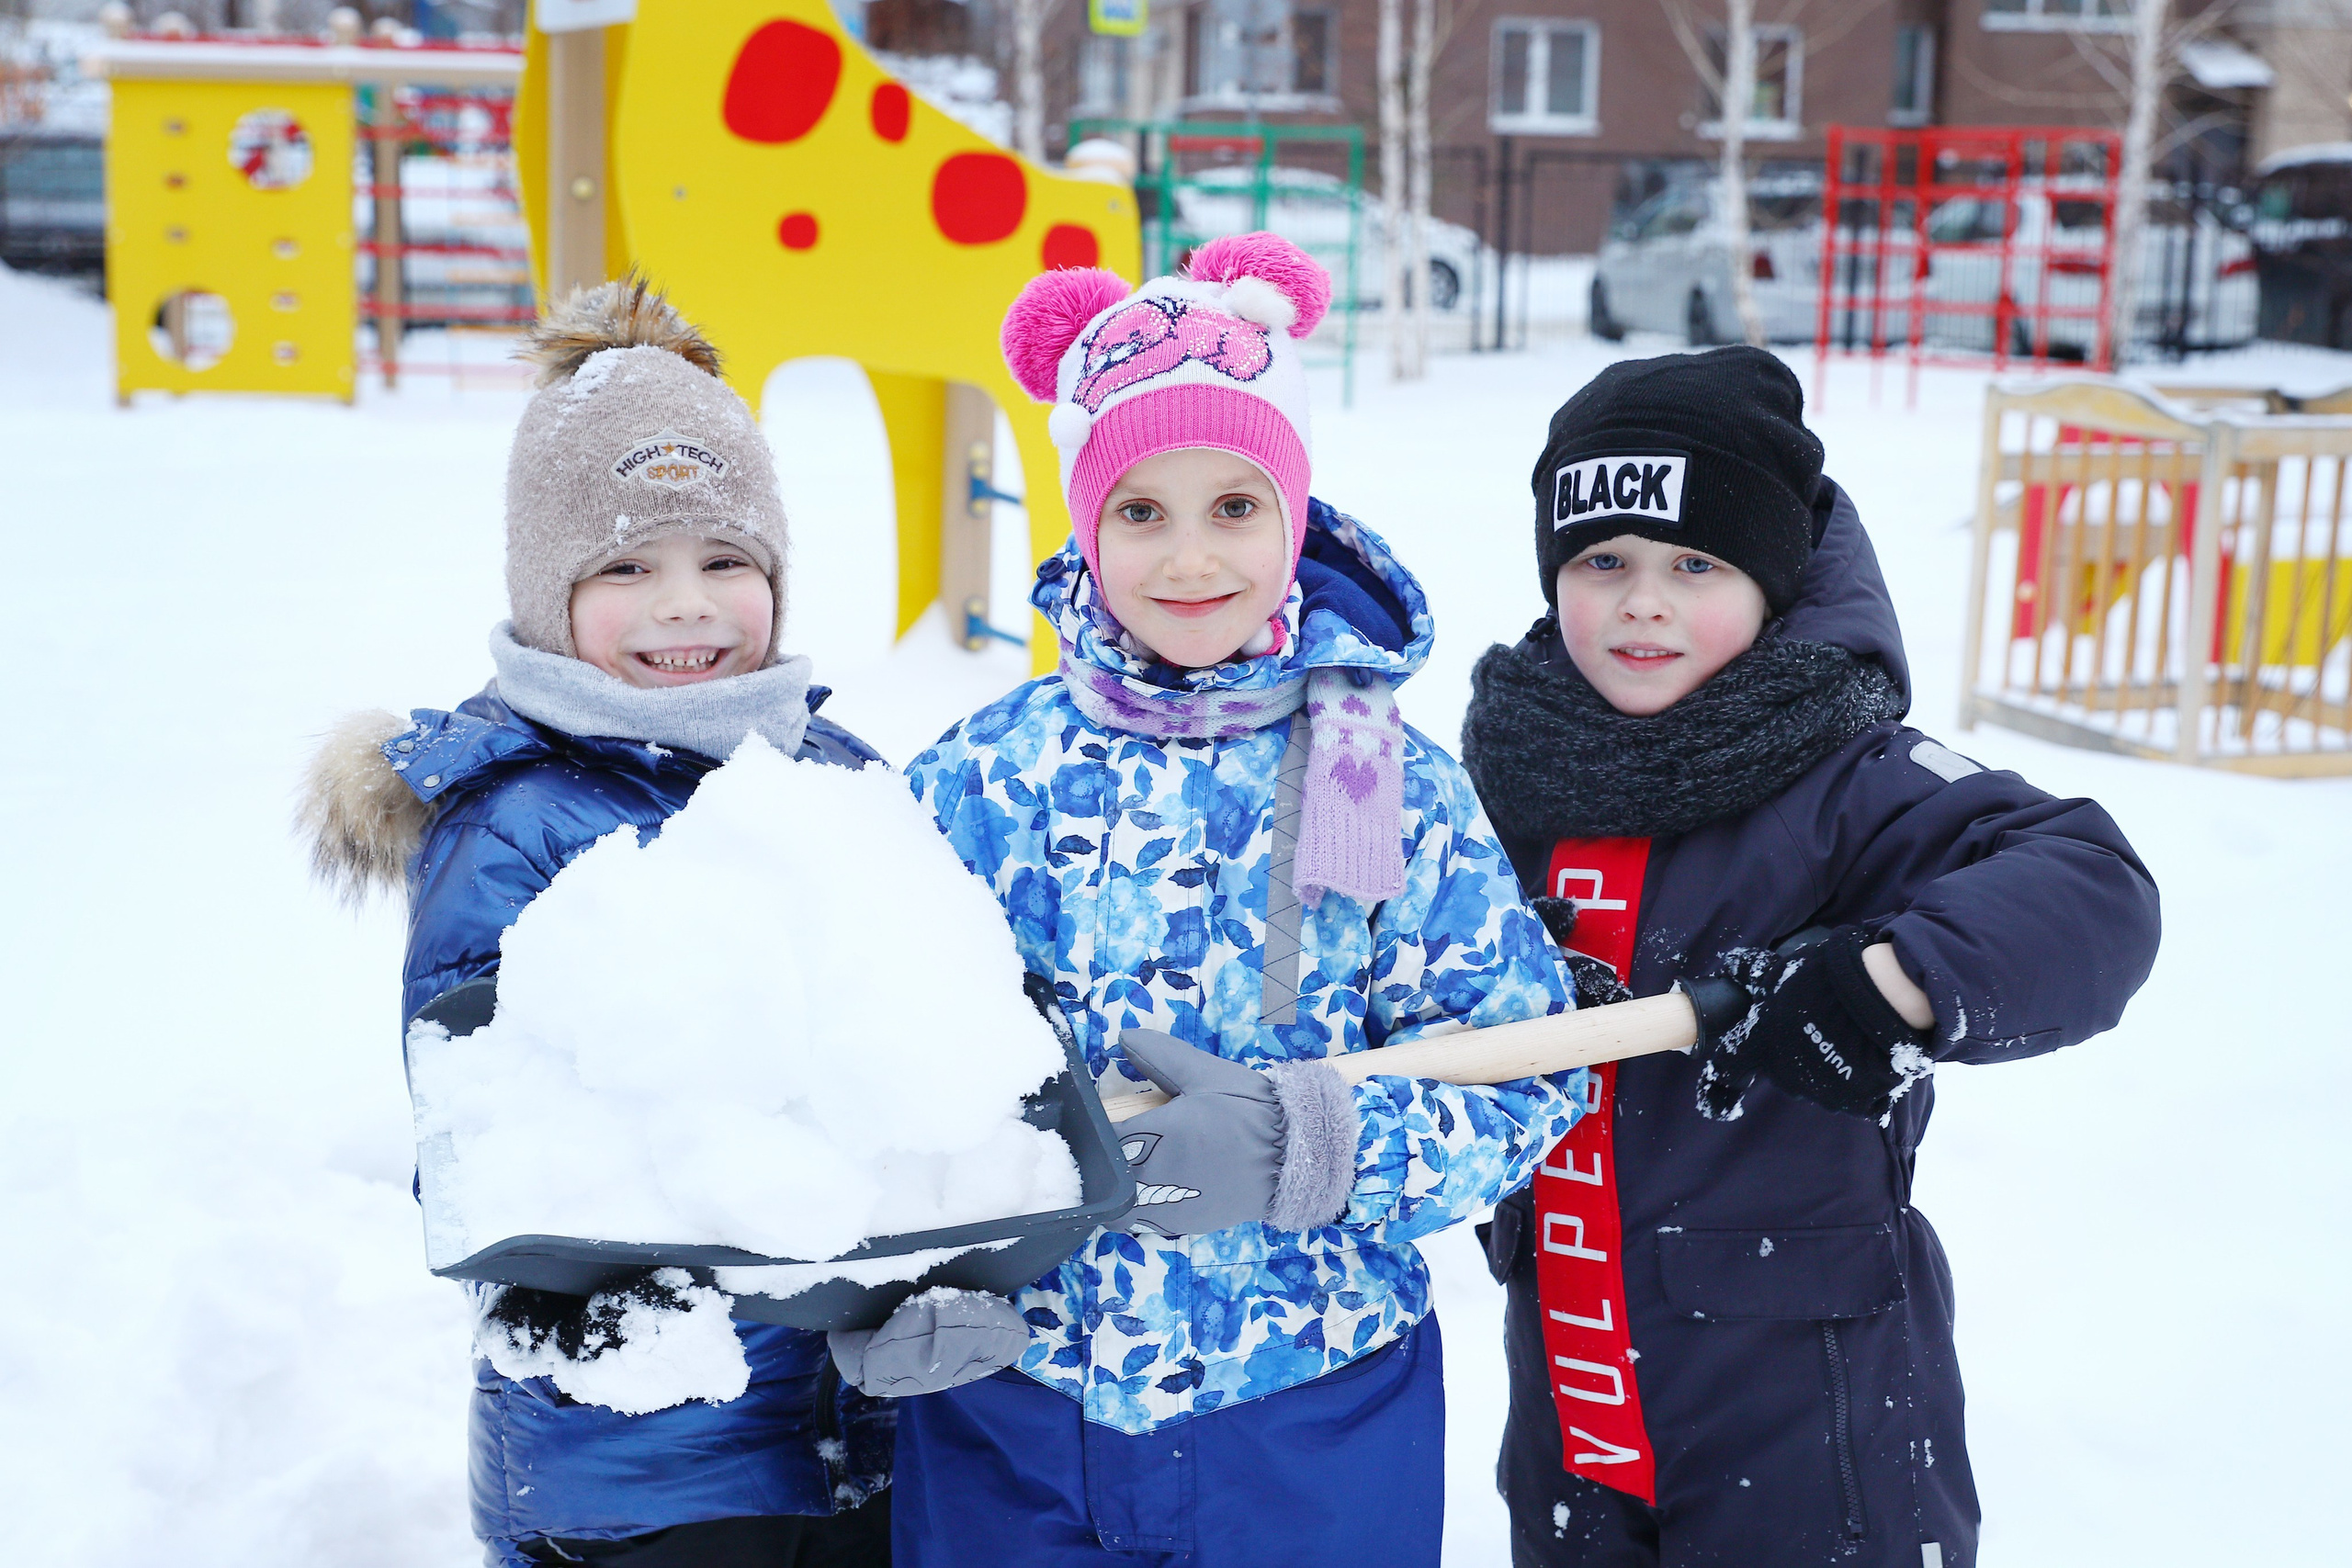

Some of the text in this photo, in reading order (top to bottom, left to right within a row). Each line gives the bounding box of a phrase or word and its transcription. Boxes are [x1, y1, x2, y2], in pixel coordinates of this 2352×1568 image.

[616, 445, 723, 477] HIGH TECH
[646, 463, 699, 481] SPORT
[1556, 462, 1672, 521] BLACK
